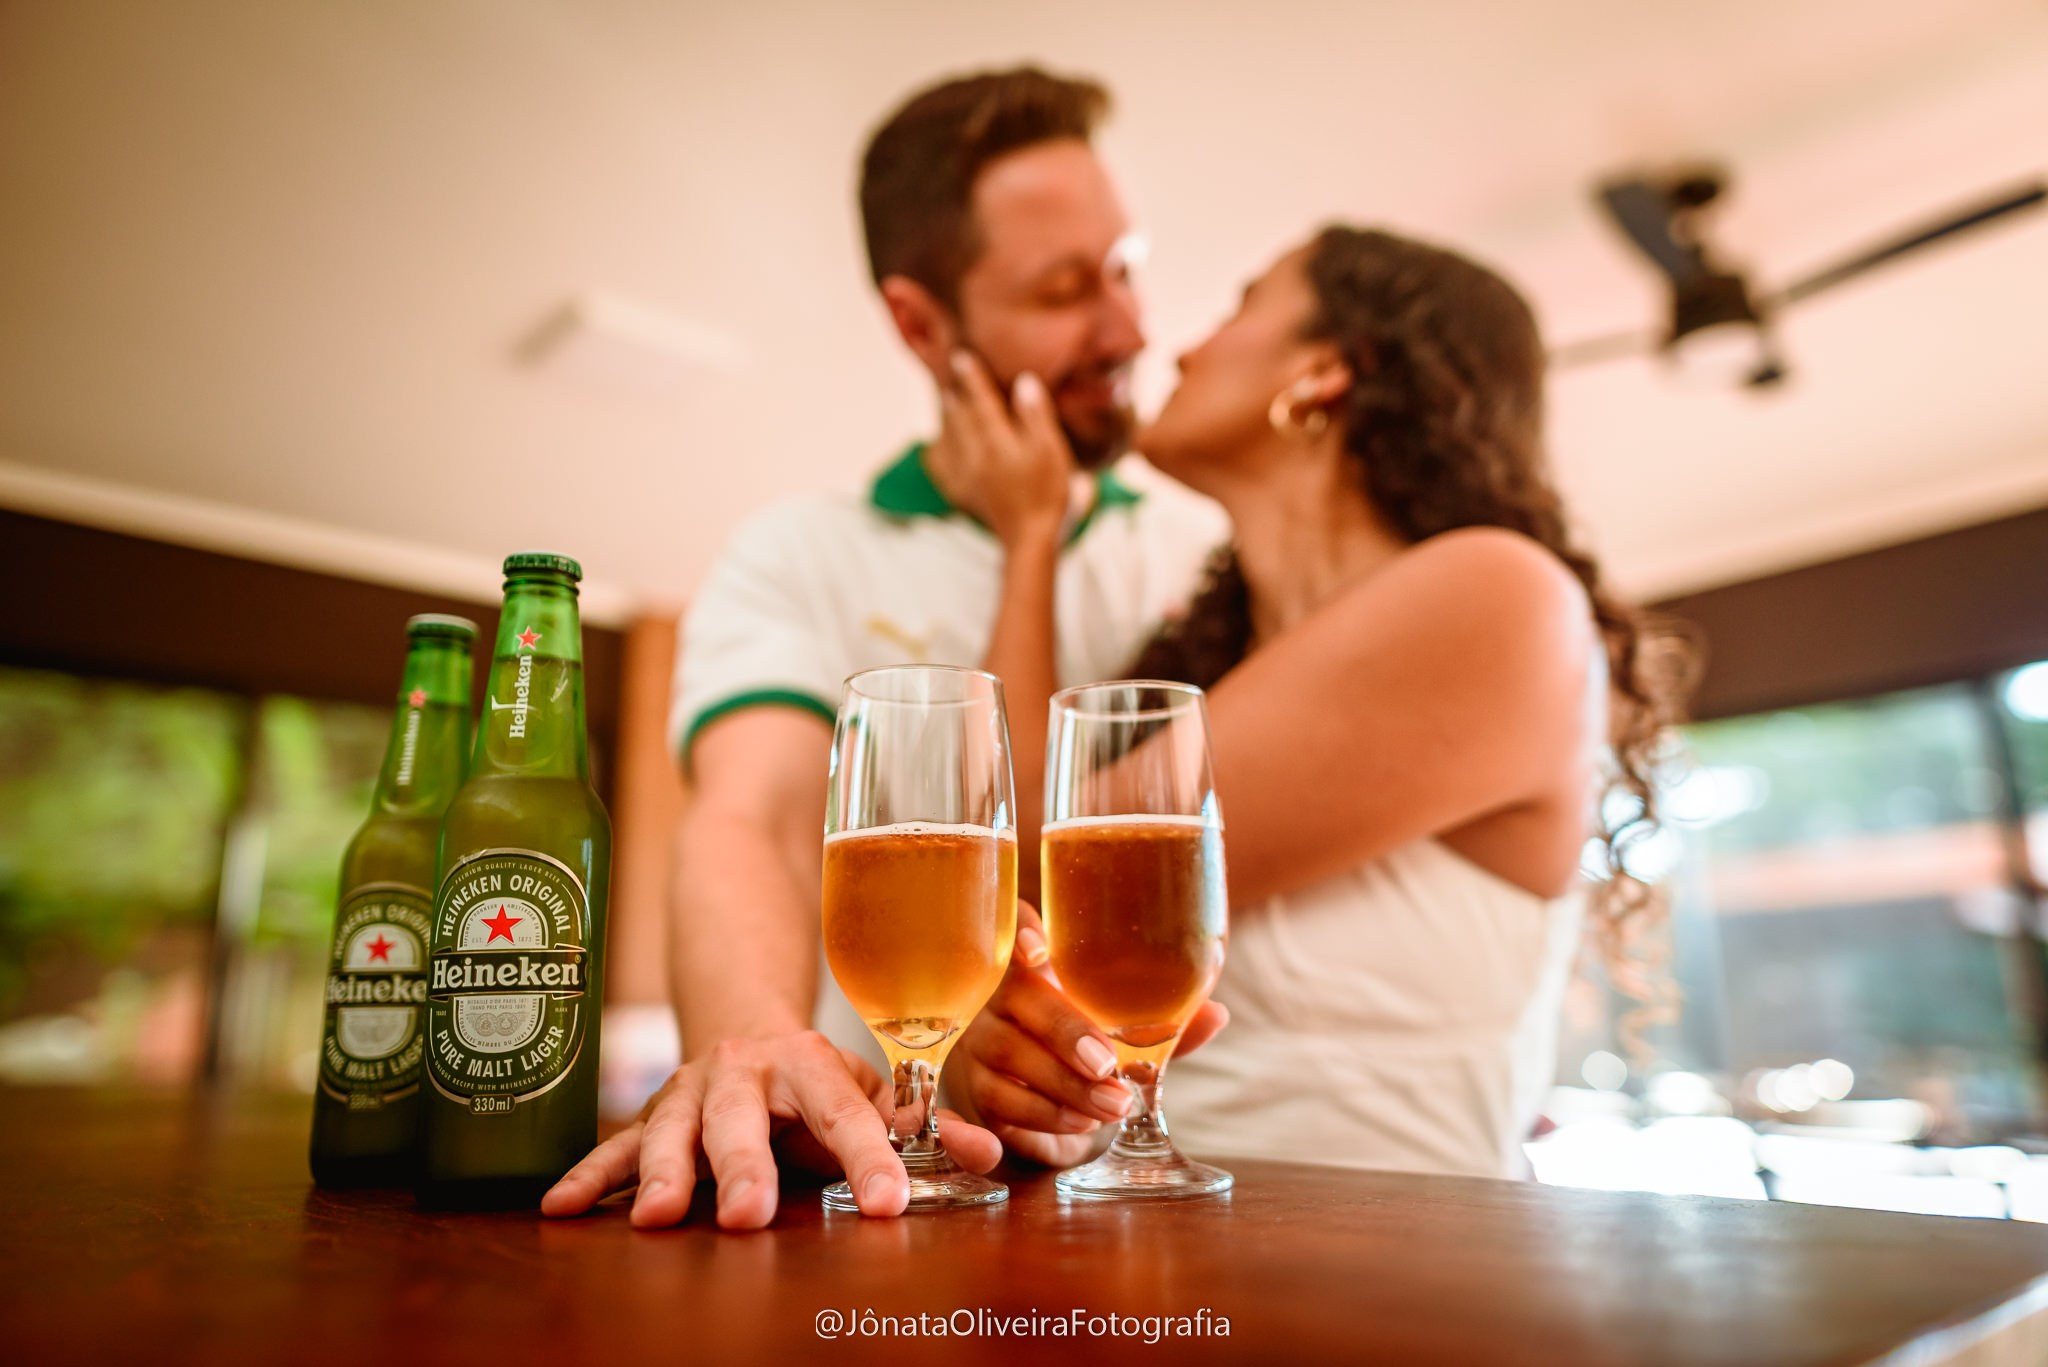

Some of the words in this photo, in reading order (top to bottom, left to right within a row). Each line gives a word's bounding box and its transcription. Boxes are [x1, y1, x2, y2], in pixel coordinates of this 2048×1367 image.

[509, 655, 533, 738] Heineken
[485, 862, 516, 871] QUALITY
[519, 862, 542, 874] LAGER
[544, 870, 560, 884] BEER
[442, 874, 502, 937] HEINEKEN
[509, 874, 571, 934] ORIGINAL
[432, 956, 580, 990] Heineken
[437, 1029, 465, 1070] PURE
[466, 1058, 513, 1078] MALT
[521, 1025, 564, 1071] LAGER
[434, 1060, 451, 1081] UNIQUE
[452, 1079, 475, 1090] RECIPE
[477, 1083, 497, 1091] WITH
[500, 1076, 537, 1090] HEINEKEN
[474, 1097, 510, 1112] 330ml
